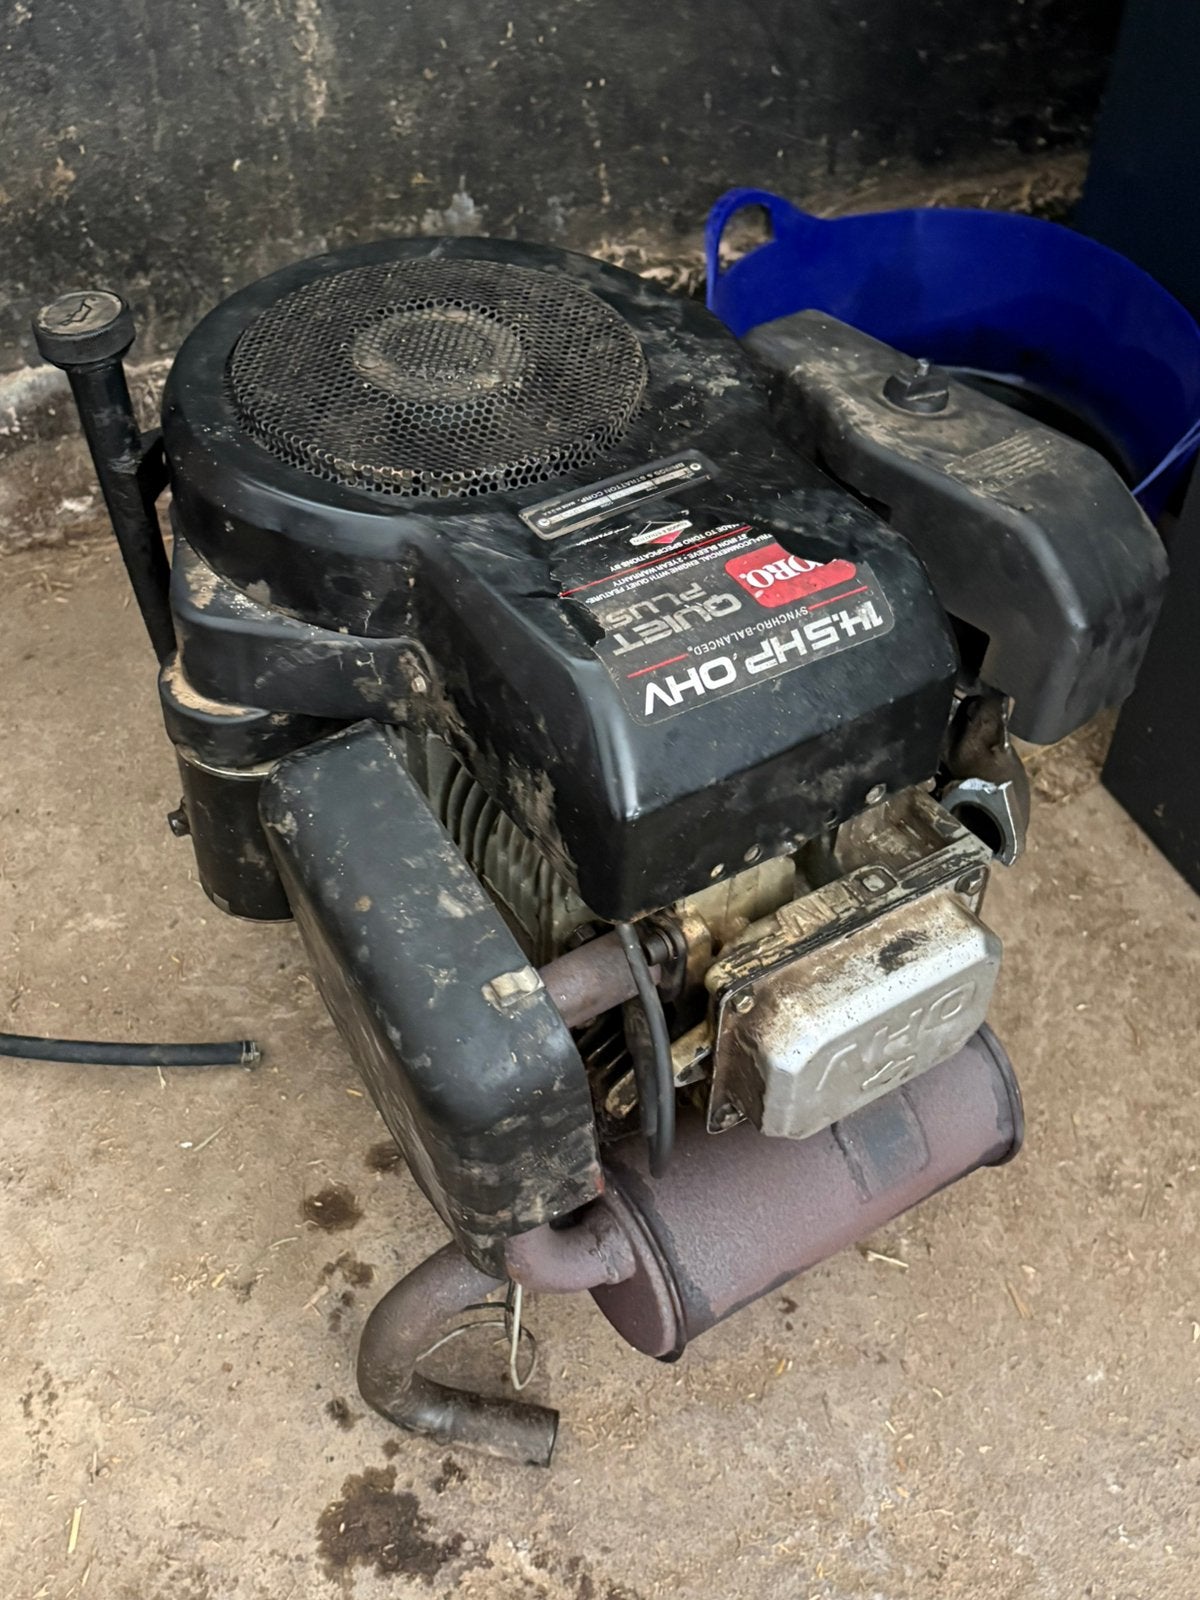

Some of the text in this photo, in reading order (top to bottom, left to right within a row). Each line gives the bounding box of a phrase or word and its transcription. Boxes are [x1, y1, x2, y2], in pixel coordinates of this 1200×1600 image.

[603, 475, 646, 493] STRATTON
[577, 490, 603, 503] CORP.
[681, 533, 704, 545] TORO
[704, 528, 717, 536] TO
[717, 537, 737, 548] IRON
[621, 541, 682, 567] SPECIFICATIONS
[686, 544, 717, 559] SLEEVE
[611, 562, 621, 571] BY
[655, 558, 678, 570] YEAR
[667, 558, 698, 573] ENGINE
[613, 566, 656, 586] WARRANTY
[649, 570, 669, 580] WITH
[740, 557, 834, 590] ORO
[624, 577, 647, 590] QUIET
[604, 581, 705, 629] PLUS
[612, 590, 742, 655] QUIET
[645, 600, 882, 715] 14.5 HP OHV
[814, 981, 976, 1091] OHV
